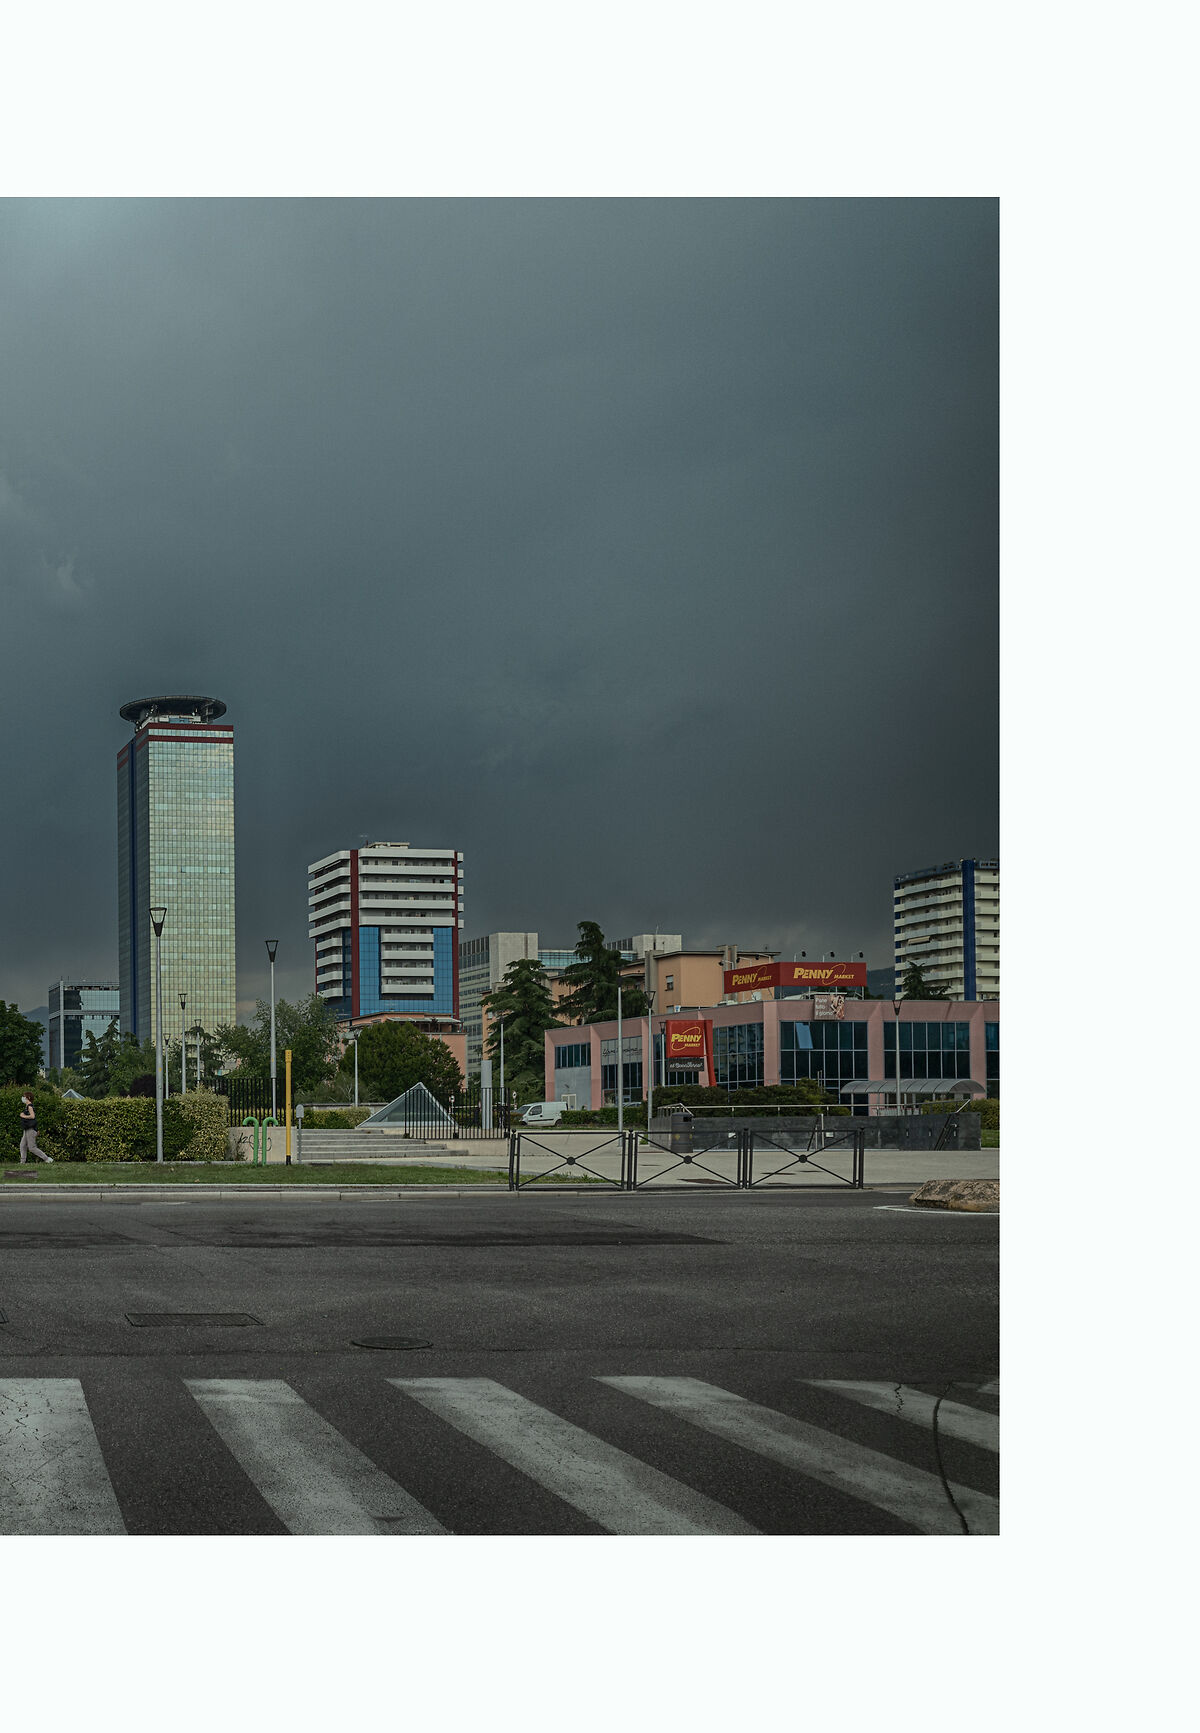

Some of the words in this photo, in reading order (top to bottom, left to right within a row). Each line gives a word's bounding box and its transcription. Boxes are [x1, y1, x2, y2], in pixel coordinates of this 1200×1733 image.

[793, 967, 834, 979] PENNY
[732, 973, 758, 986] PENNY
[671, 1033, 702, 1043] PENNY
